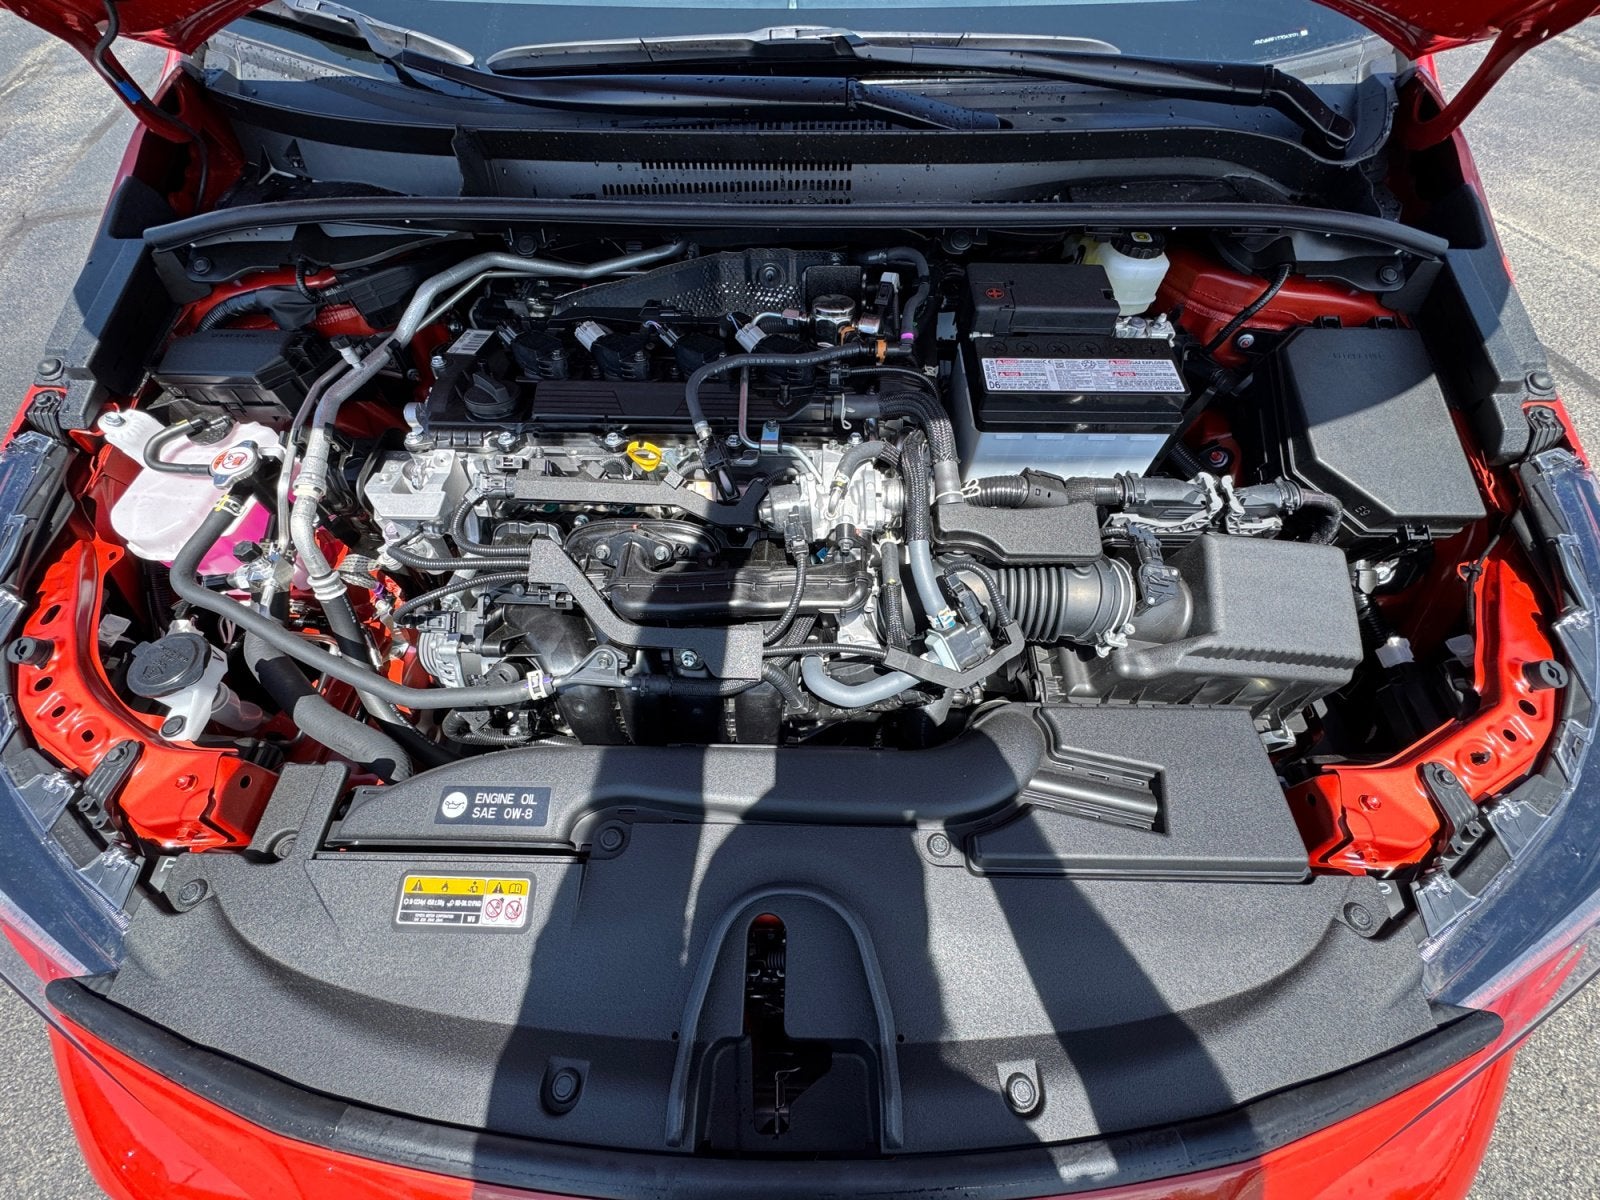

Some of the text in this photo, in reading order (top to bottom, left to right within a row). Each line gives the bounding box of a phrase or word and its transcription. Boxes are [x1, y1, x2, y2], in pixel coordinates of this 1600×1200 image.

[988, 381, 1001, 389] D6
[474, 792, 538, 805] ENGINE OIL
[472, 807, 533, 819] SAE 0W-8
